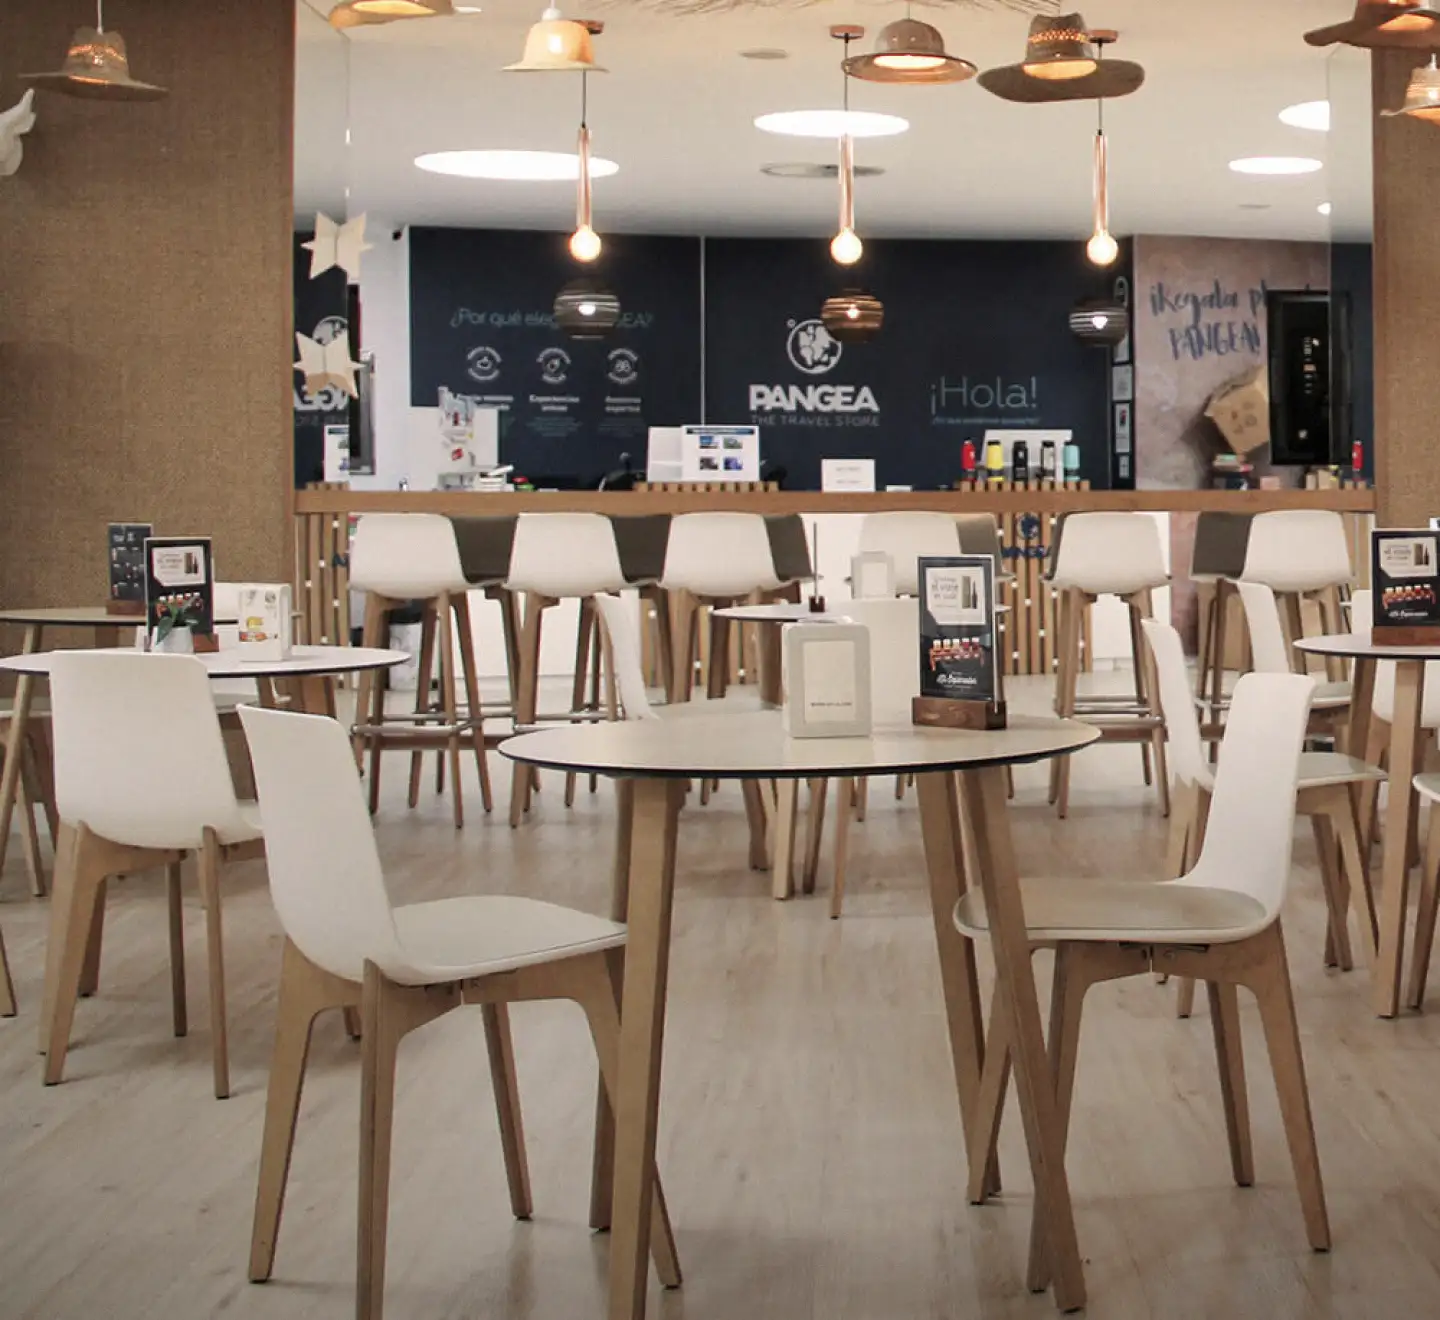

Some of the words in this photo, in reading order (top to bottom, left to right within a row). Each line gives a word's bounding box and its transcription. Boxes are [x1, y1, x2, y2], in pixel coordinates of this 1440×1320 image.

[749, 383, 881, 413] PANGEA
[930, 375, 1037, 416] ¡Hola!
[751, 415, 776, 427] THE
[781, 415, 832, 427] TRAVEL
[835, 415, 880, 427] STORE
